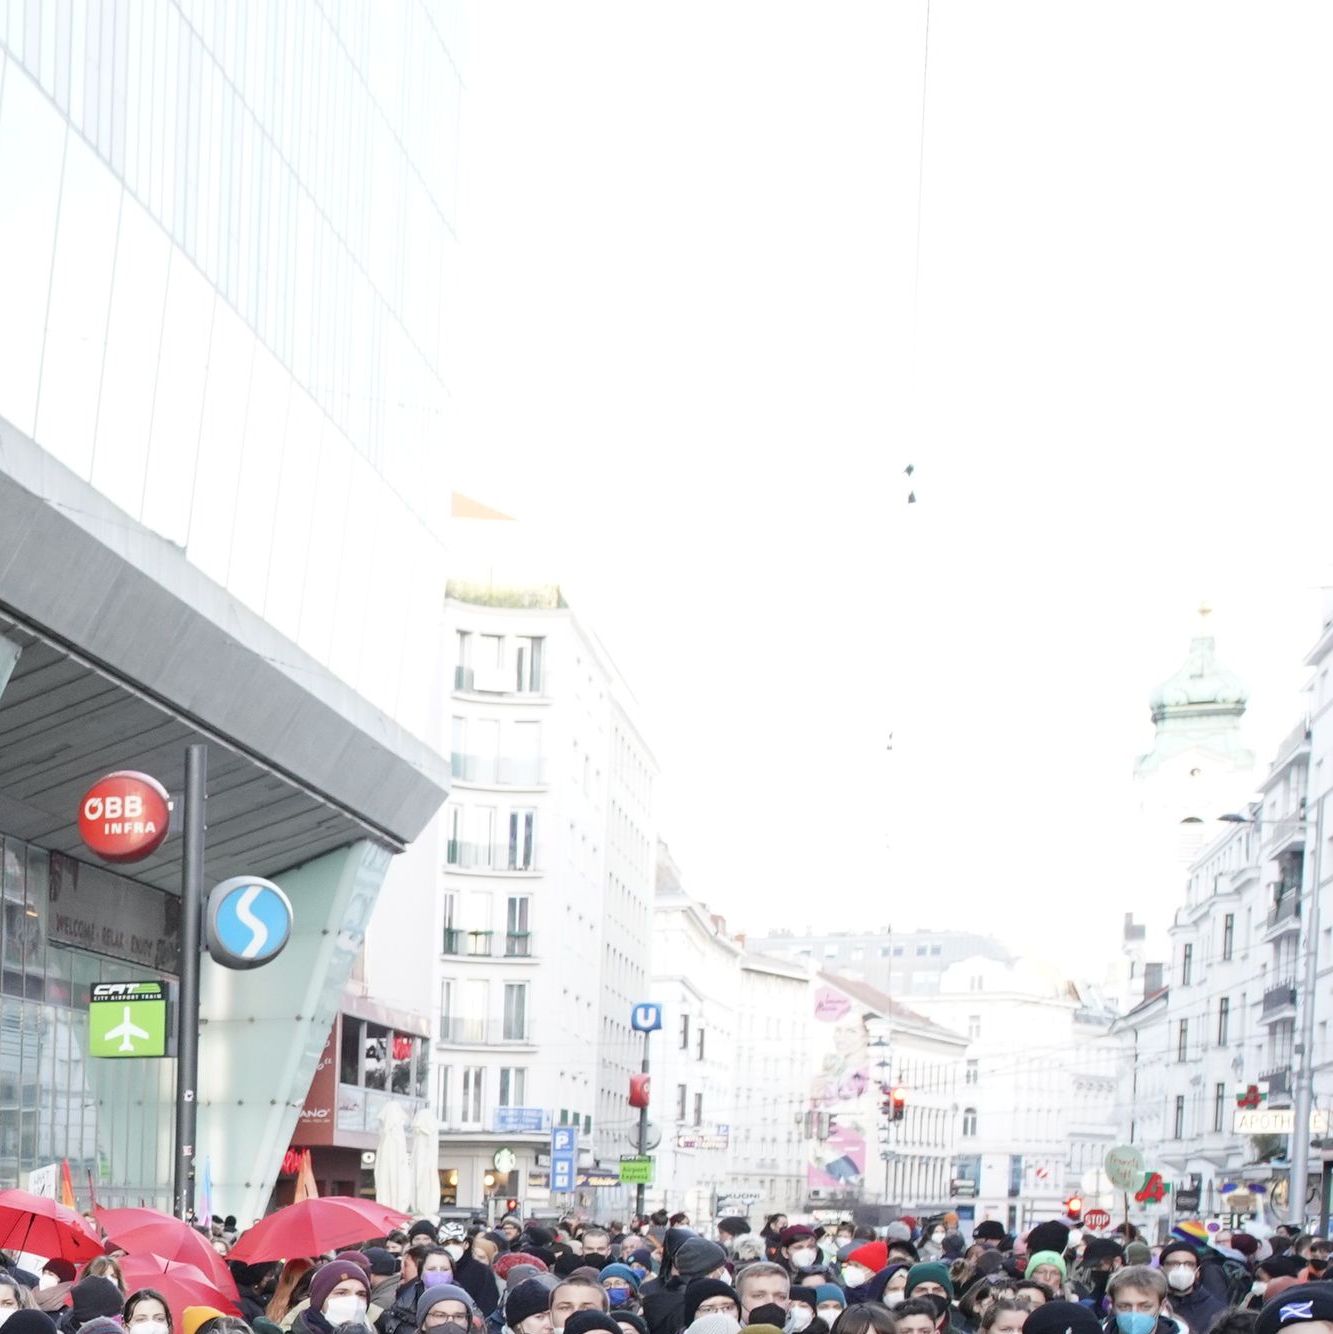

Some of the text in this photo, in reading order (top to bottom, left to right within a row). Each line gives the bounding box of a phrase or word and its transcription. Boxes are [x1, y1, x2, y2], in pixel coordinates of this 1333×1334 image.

[84, 795, 143, 821] ÖBB
[104, 821, 156, 835] INFRA
[94, 983, 141, 995] CAT
[636, 1007, 657, 1028] U
[622, 1166, 648, 1174] Airport
[1085, 1213, 1109, 1225] STOP
